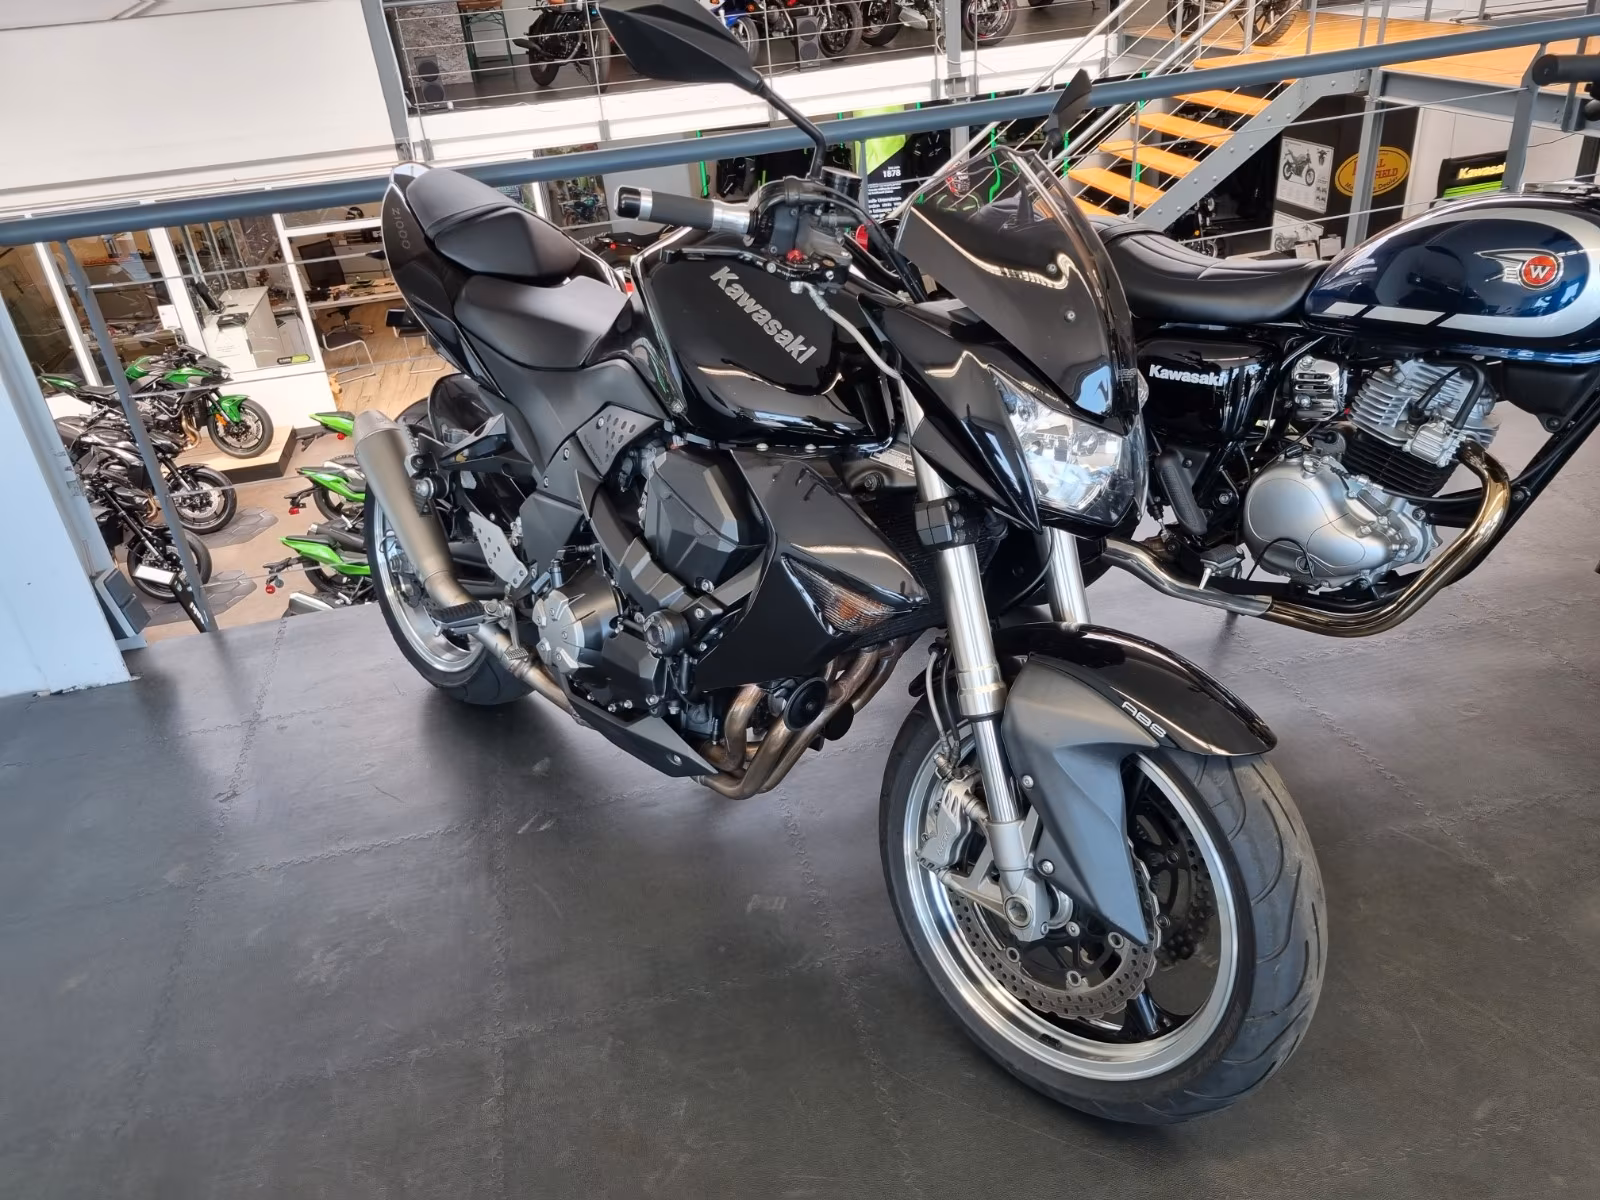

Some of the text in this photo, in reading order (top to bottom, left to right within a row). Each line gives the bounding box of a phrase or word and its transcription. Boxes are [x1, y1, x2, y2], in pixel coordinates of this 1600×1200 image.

[883, 169, 901, 178] 1878
[1375, 167, 1399, 179] FIELD
[391, 207, 411, 250] Z1000
[1529, 264, 1552, 279] W
[709, 265, 818, 364] Kawasaki
[1148, 363, 1230, 387] Kawasaki
[1121, 701, 1167, 738] ABS
